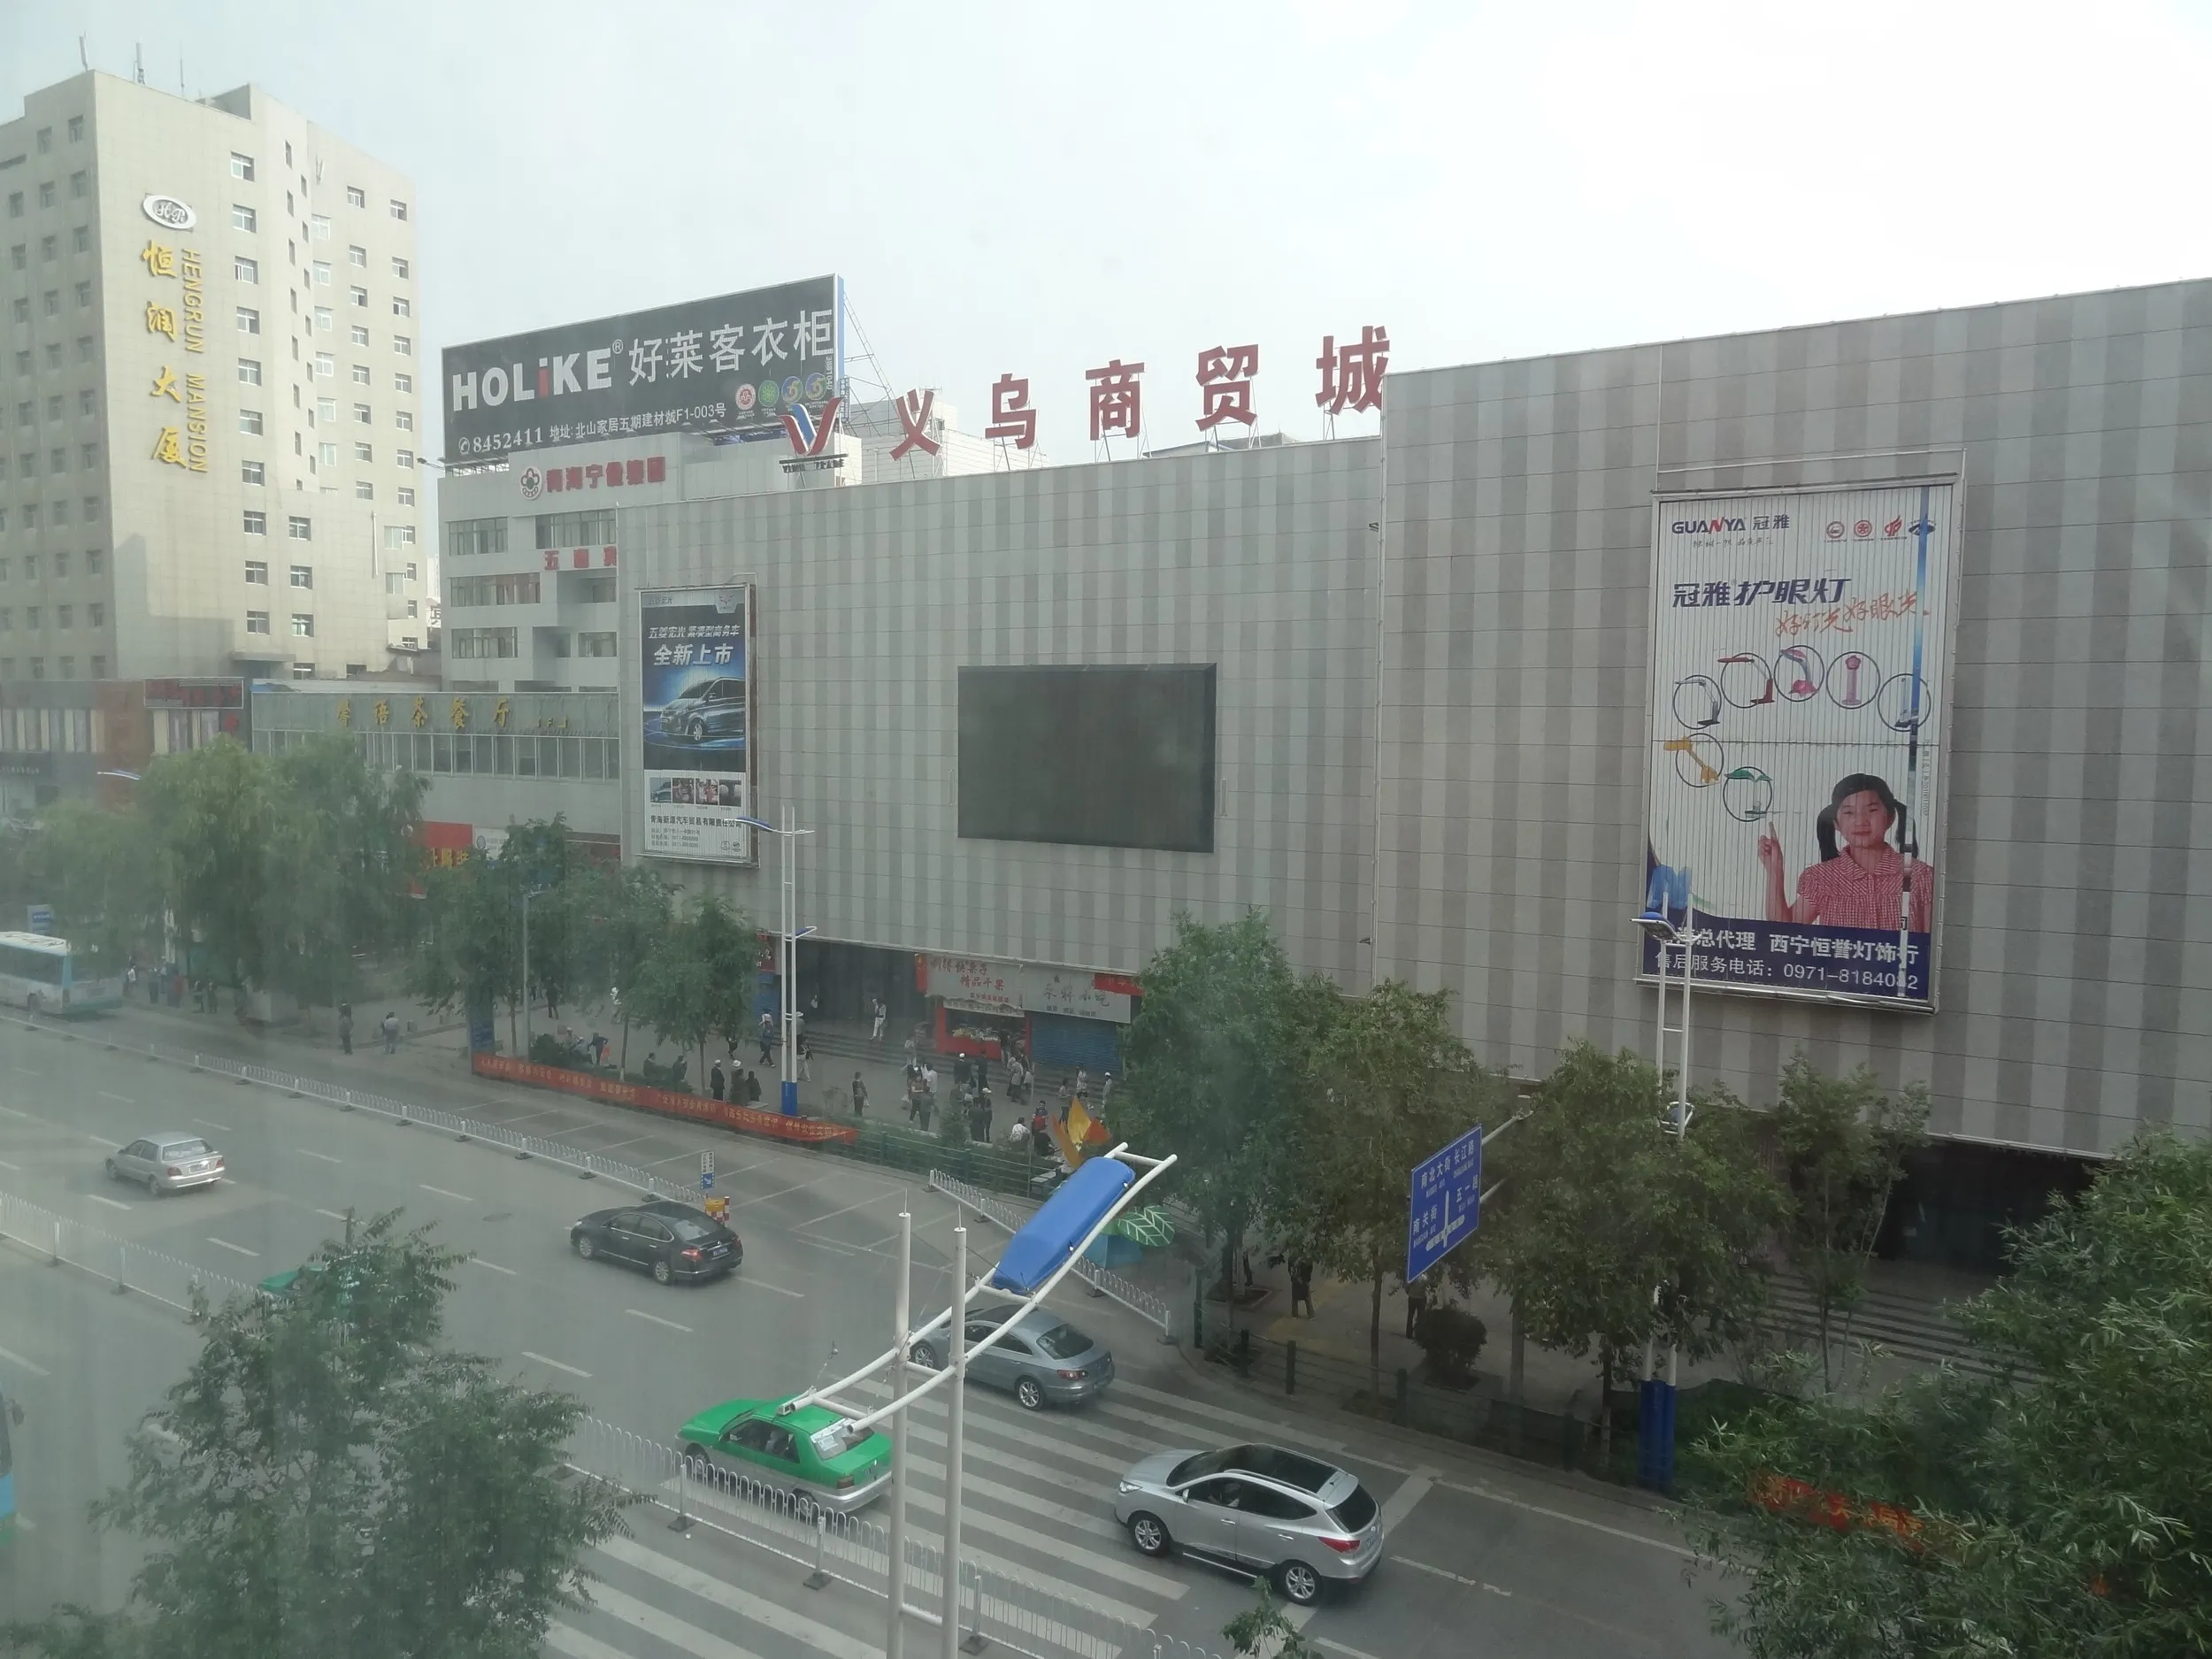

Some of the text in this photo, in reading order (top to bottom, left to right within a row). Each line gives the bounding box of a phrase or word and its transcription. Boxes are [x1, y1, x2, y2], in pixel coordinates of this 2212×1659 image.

[181, 248, 209, 473] HENGRUN MANSION
[629, 308, 834, 387] 好莱客衣柜
[888, 326, 1390, 461] 义乌商贸城
[472, 426, 543, 453] 8452411
[1671, 517, 1747, 534] GUANYA
[1753, 513, 1790, 530] 冠雅
[653, 643, 734, 665] 全新上市
